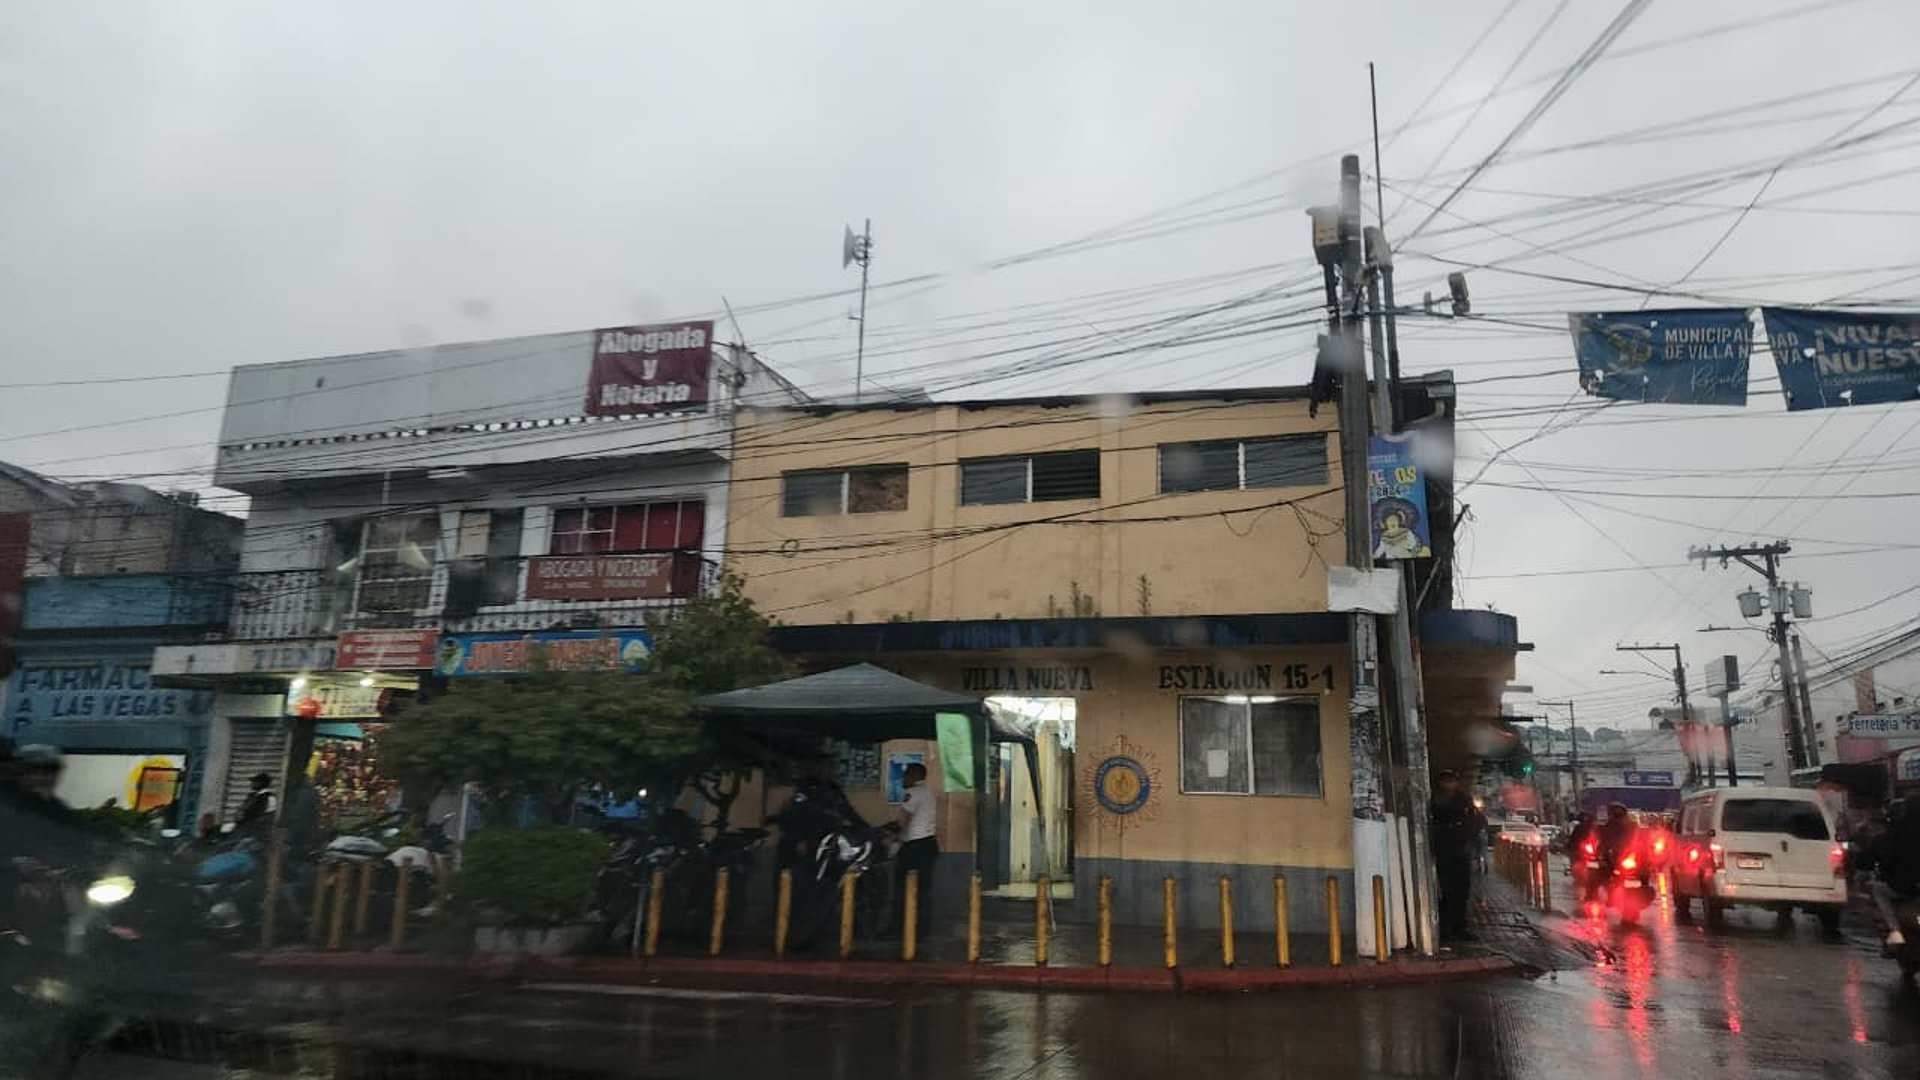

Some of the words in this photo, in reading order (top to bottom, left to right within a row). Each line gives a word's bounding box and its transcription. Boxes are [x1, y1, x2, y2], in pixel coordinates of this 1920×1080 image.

[600, 327, 705, 353] Abogada
[1664, 327, 1753, 343] MUNICIPAL
[1665, 344, 1684, 360] DE
[1688, 344, 1734, 360] VILLA
[601, 382, 691, 406] Notaria
[18, 666, 158, 692] FARMAC
[961, 666, 1019, 691] VILLA
[1026, 666, 1093, 691] NUEVA
[1158, 665, 1272, 690] ESTACION
[1283, 664, 1335, 690] 15-1
[52, 696, 96, 718] LAS
[104, 694, 178, 717] VEGAS
